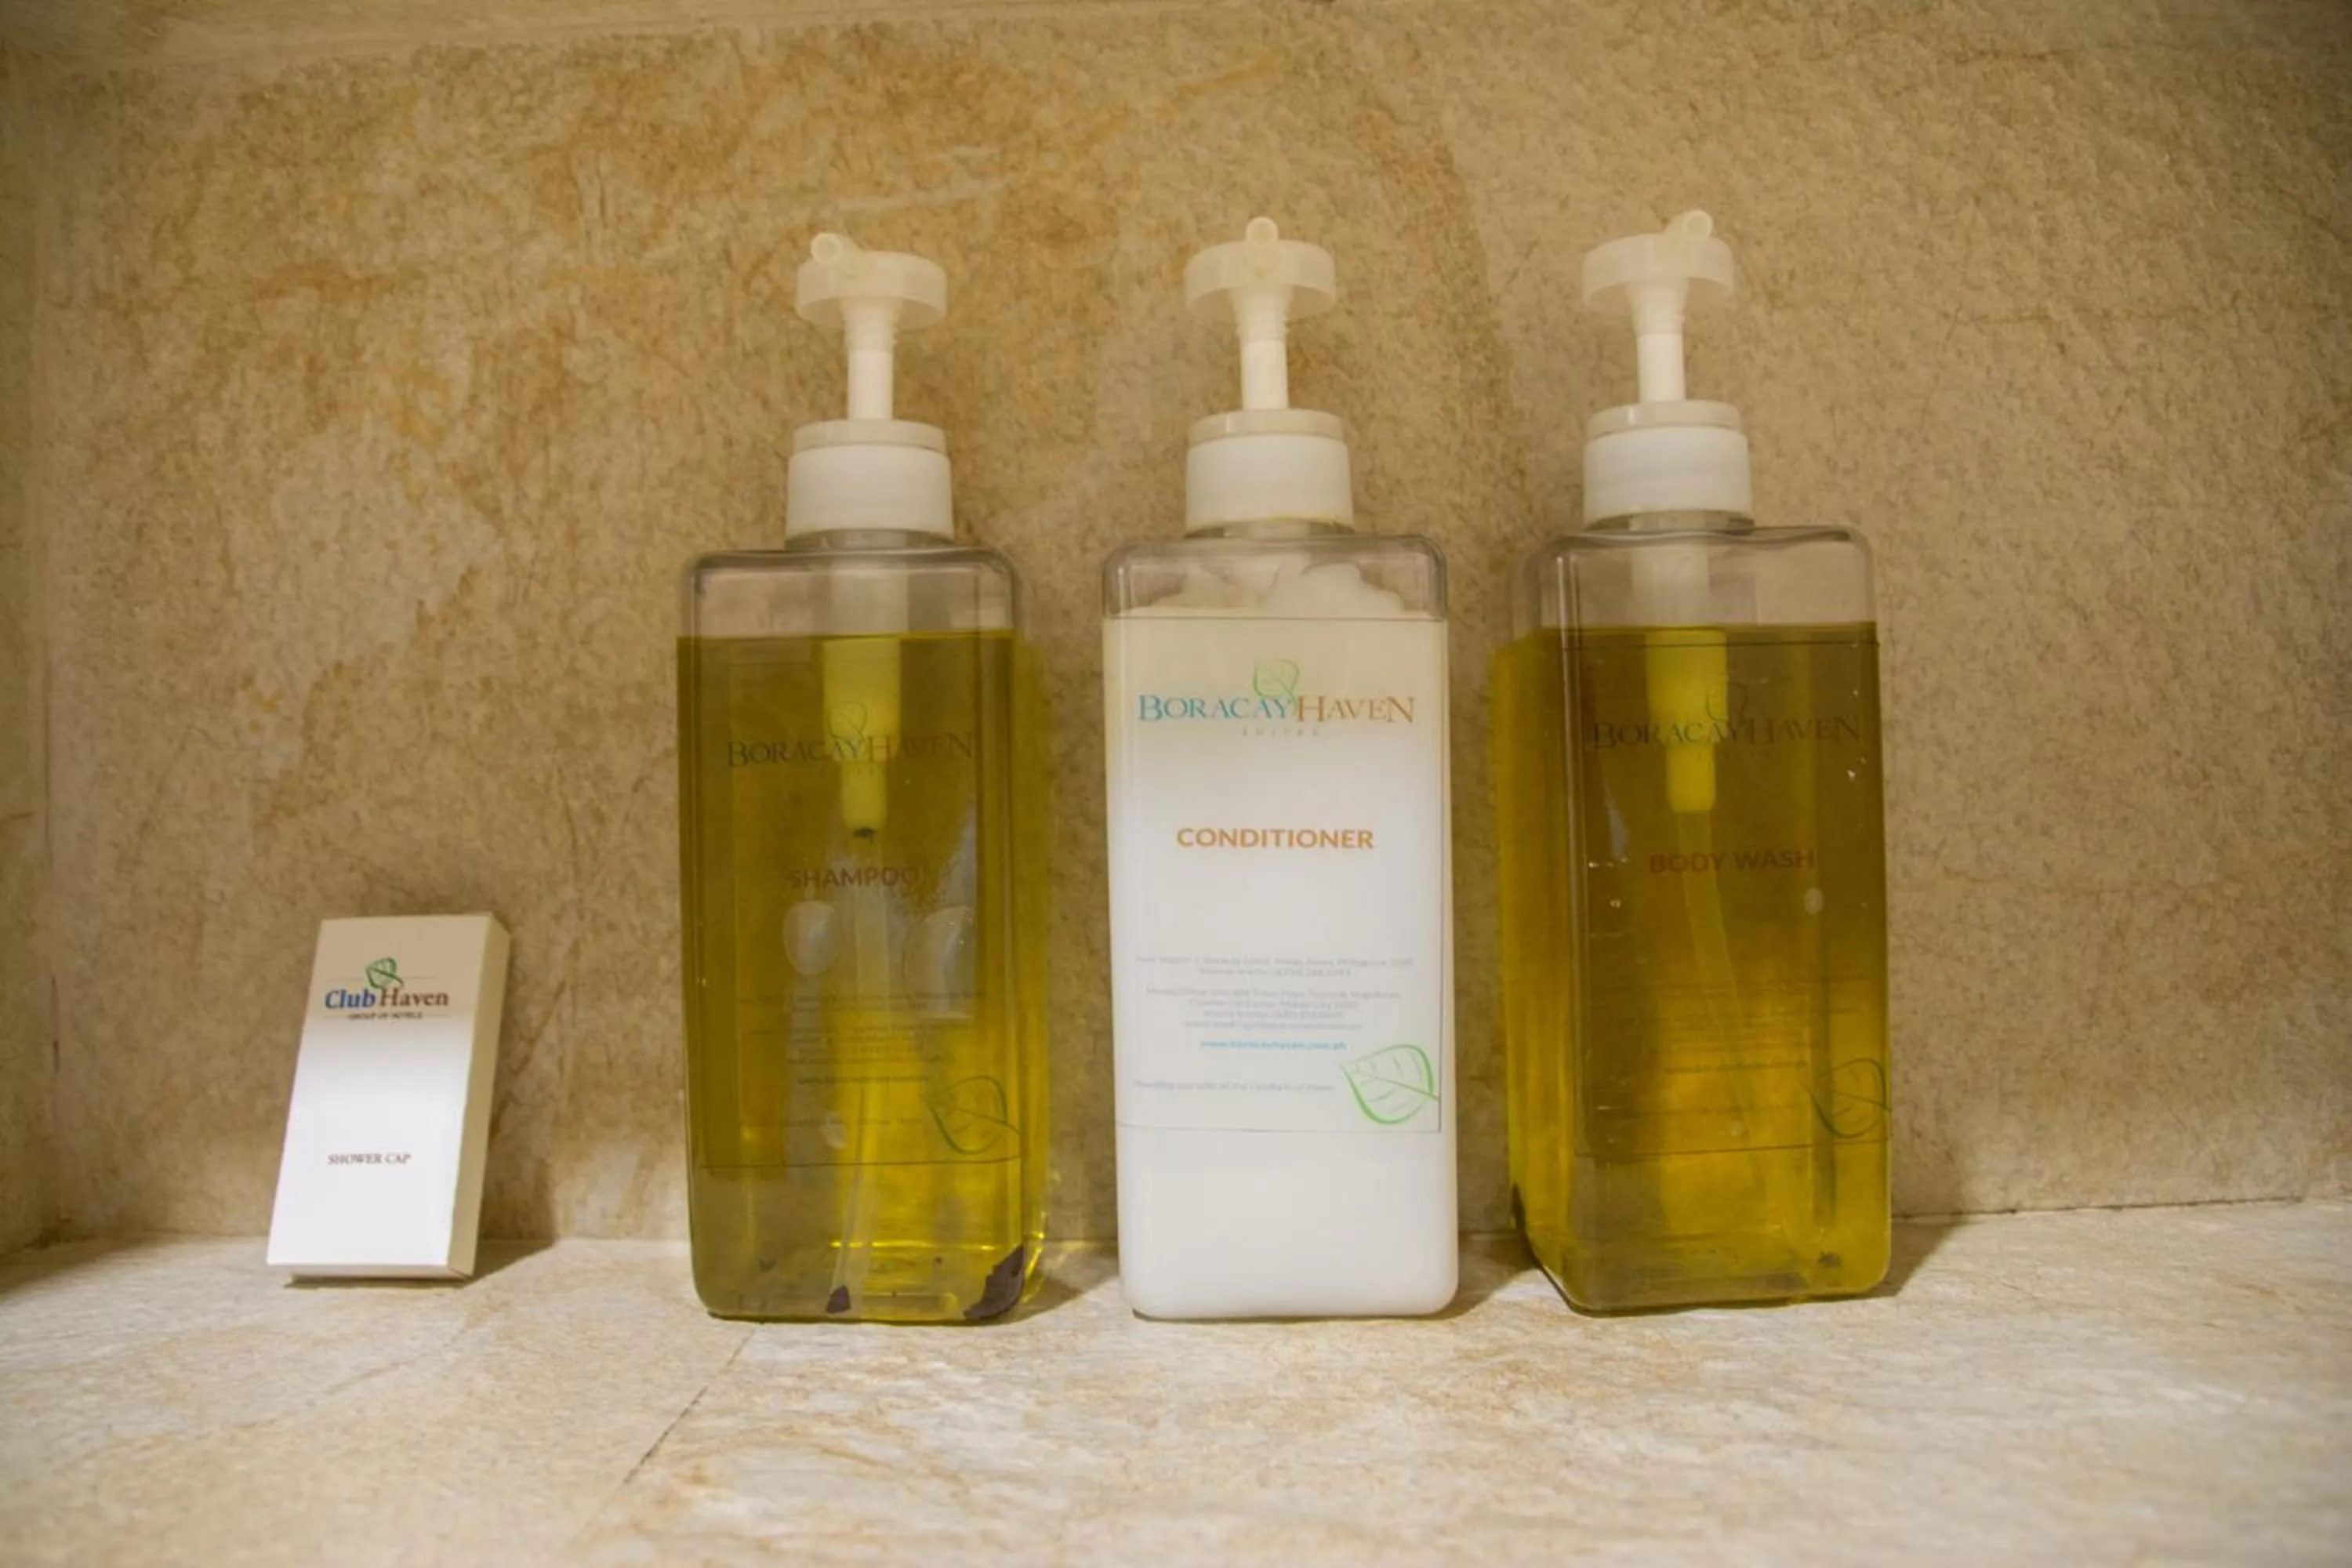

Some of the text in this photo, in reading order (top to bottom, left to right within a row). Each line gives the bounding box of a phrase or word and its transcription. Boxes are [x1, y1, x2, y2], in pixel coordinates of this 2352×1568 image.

[1177, 827, 1375, 849] CONDITIONER
[1650, 848, 1815, 875] BODY WASH
[788, 866, 920, 889] SHAMPOO
[325, 988, 449, 1011] Club Haven
[328, 1152, 411, 1166] SHOWER CAP
